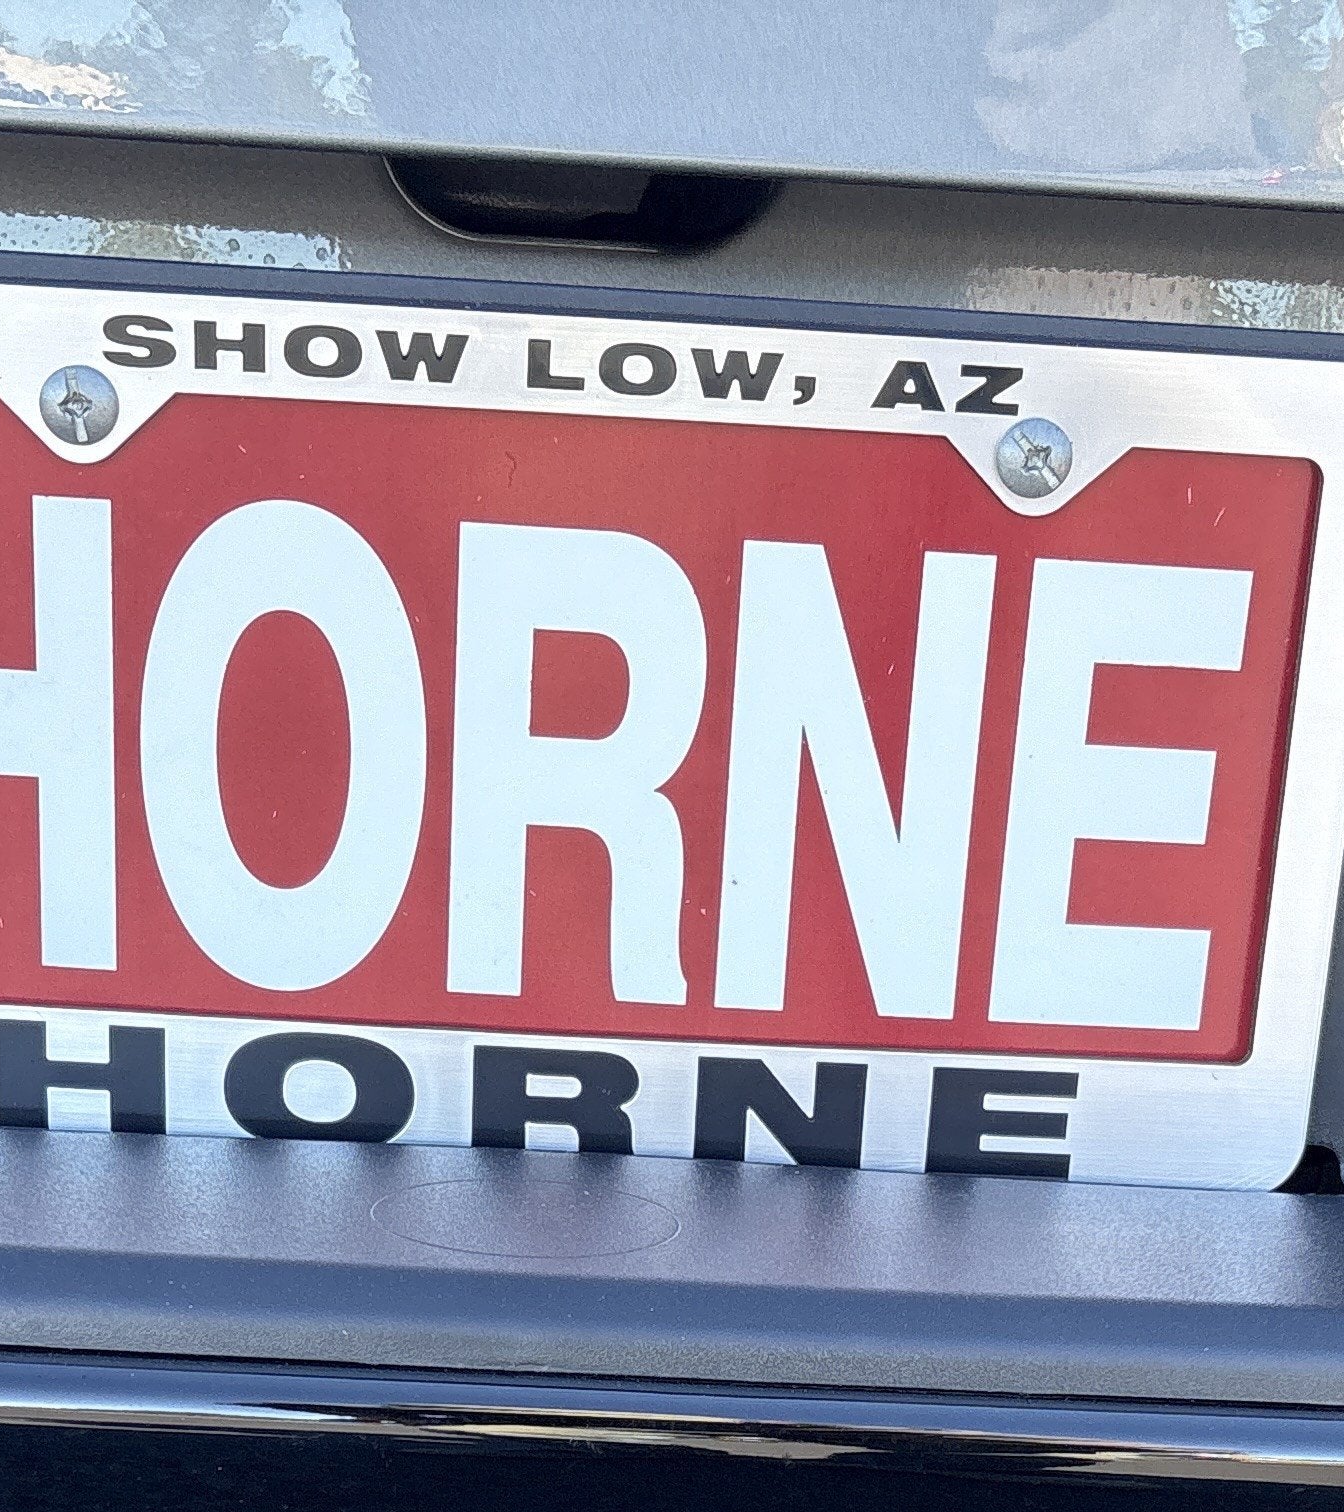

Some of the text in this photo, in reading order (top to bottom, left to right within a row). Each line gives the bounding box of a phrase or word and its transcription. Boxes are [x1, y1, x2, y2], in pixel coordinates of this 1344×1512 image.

[103, 314, 1025, 417] SHOW LOW, AZ
